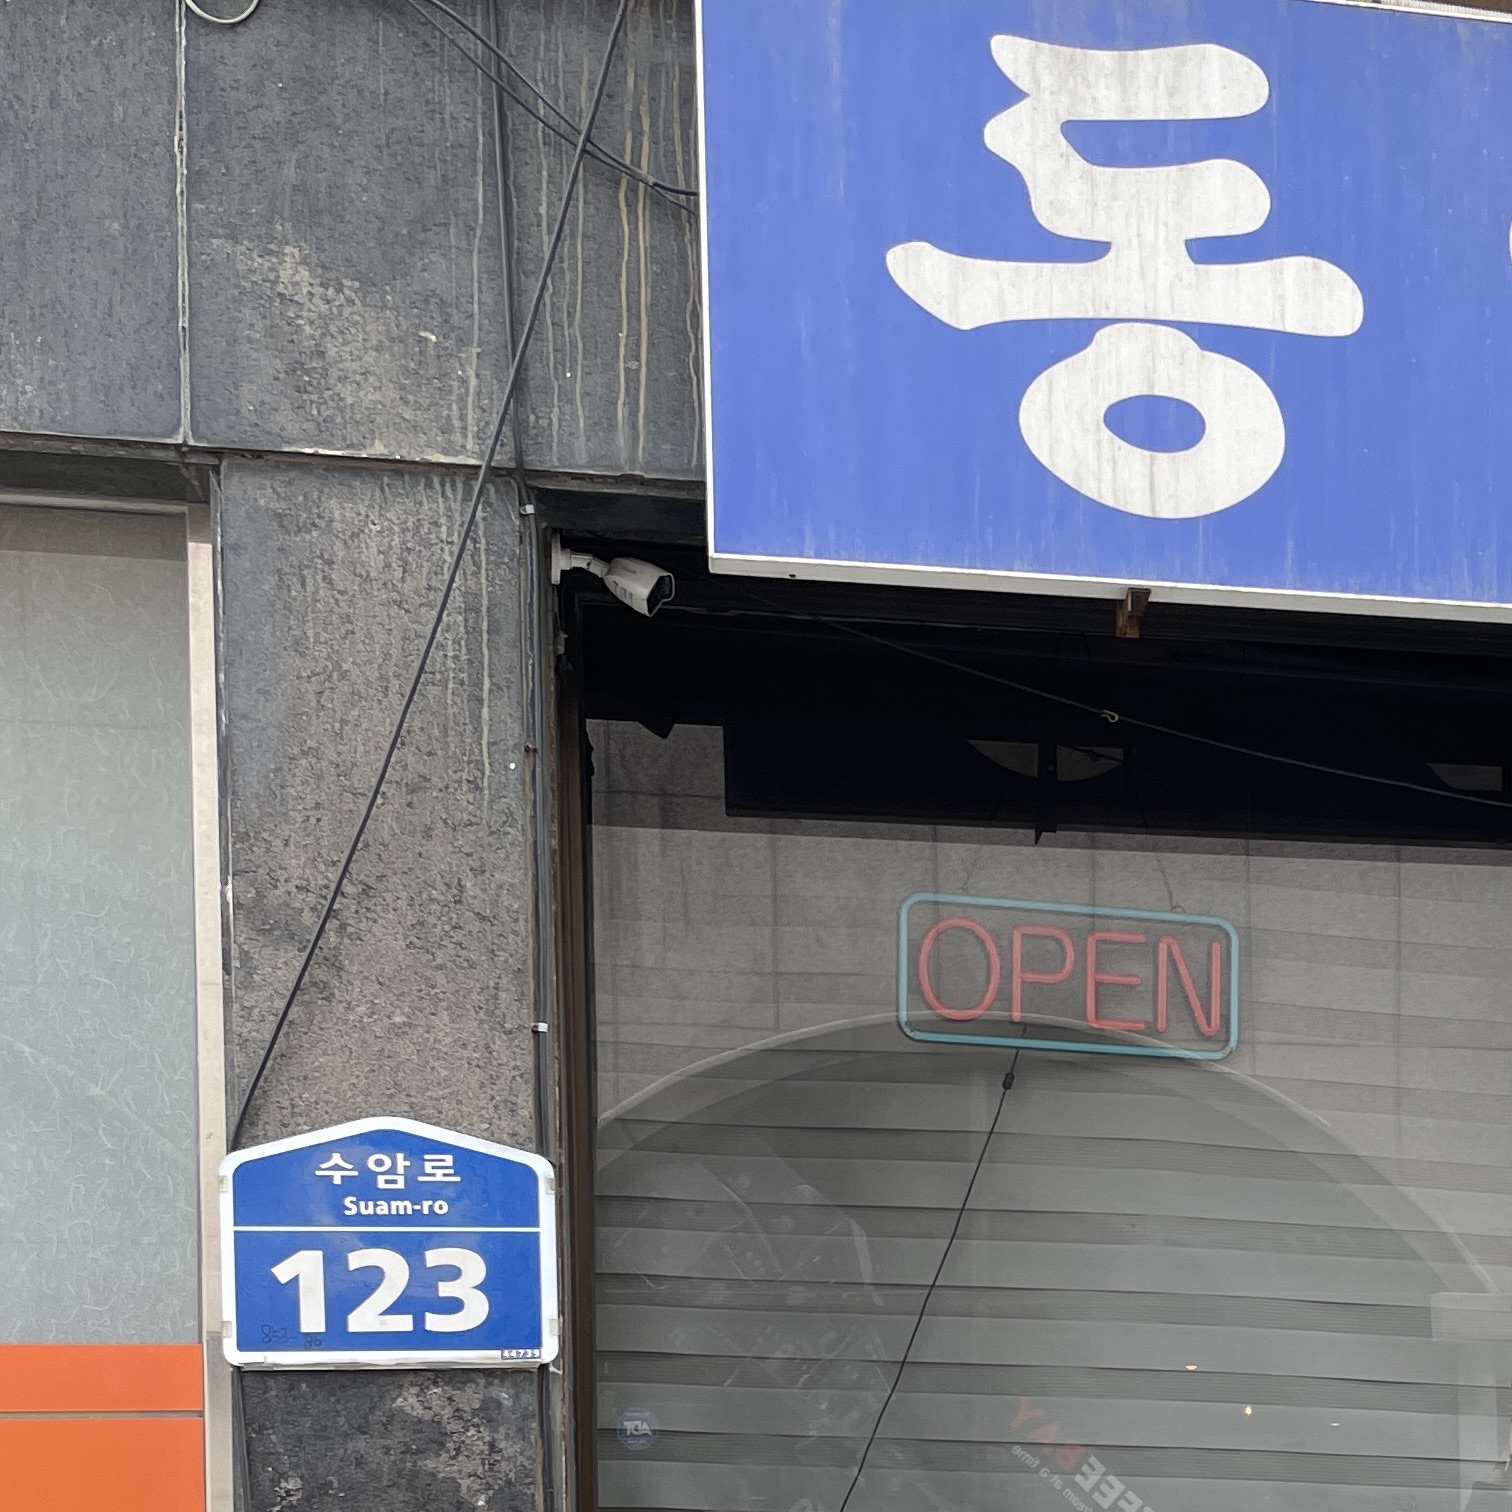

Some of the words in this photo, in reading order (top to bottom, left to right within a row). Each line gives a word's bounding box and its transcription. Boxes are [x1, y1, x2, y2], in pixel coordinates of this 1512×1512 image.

[917, 915, 1222, 1037] OPEN
[314, 1152, 462, 1190] 수암로
[343, 1195, 450, 1216] Suam-ro
[270, 1246, 490, 1333] 123
